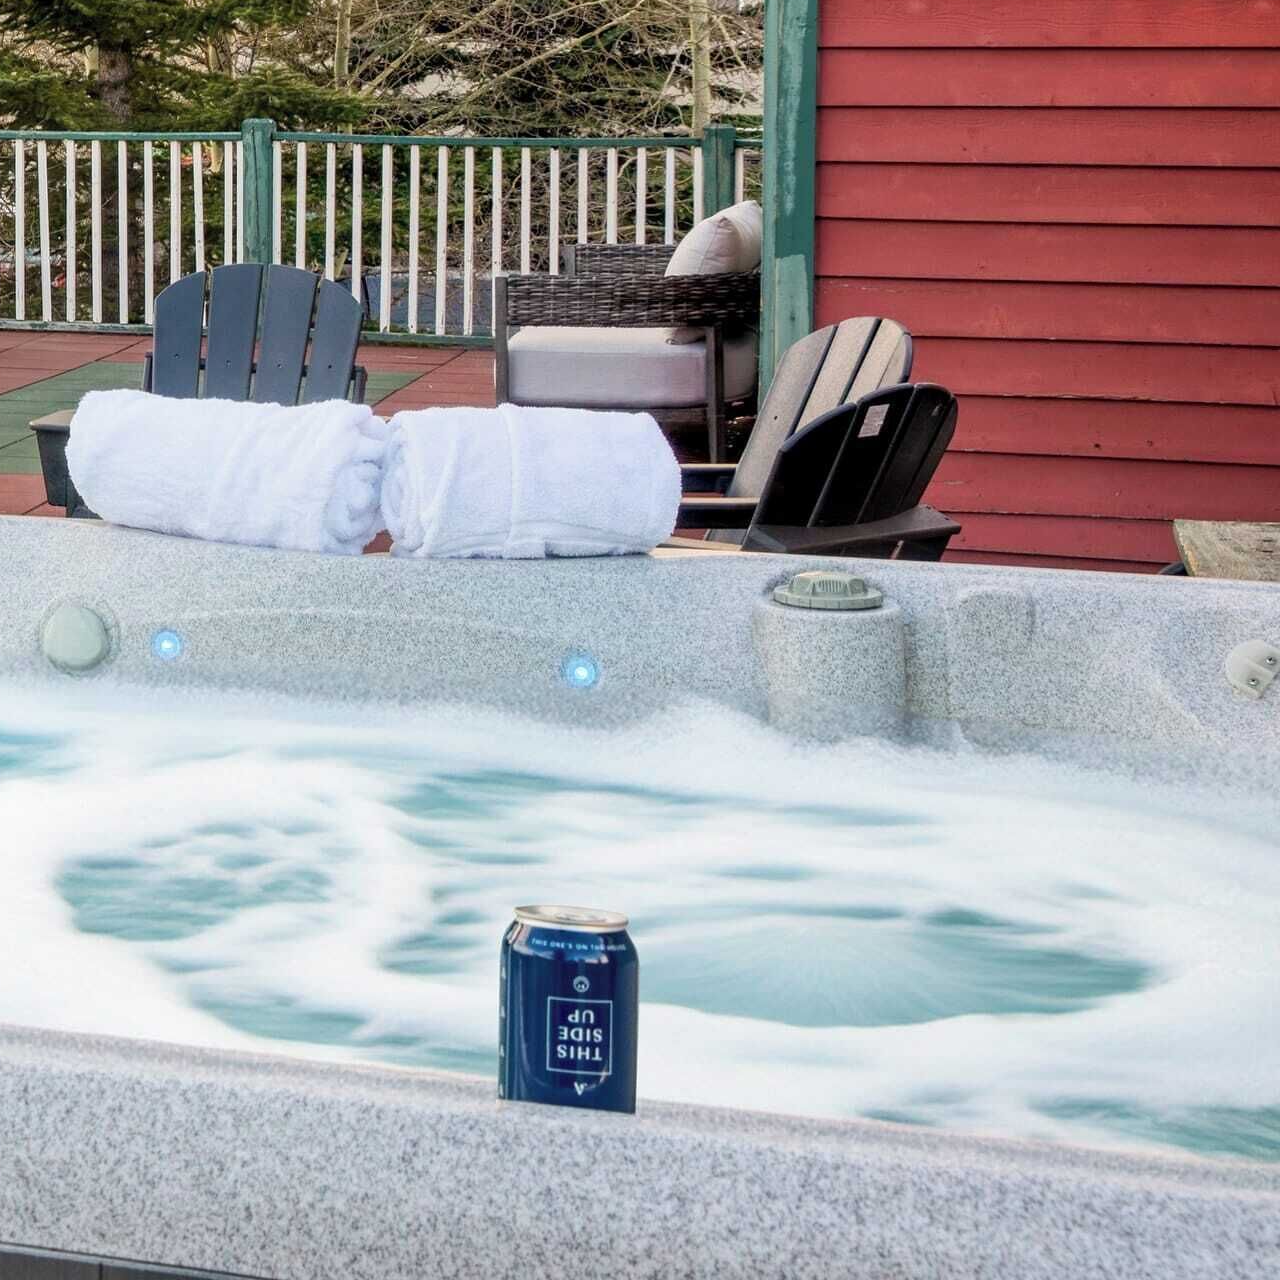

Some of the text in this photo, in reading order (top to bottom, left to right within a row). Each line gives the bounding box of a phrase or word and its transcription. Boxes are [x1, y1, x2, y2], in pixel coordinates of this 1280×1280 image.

[567, 1009, 595, 1024] UP
[557, 1025, 602, 1043] SIDE
[556, 1044, 602, 1061] THIS
